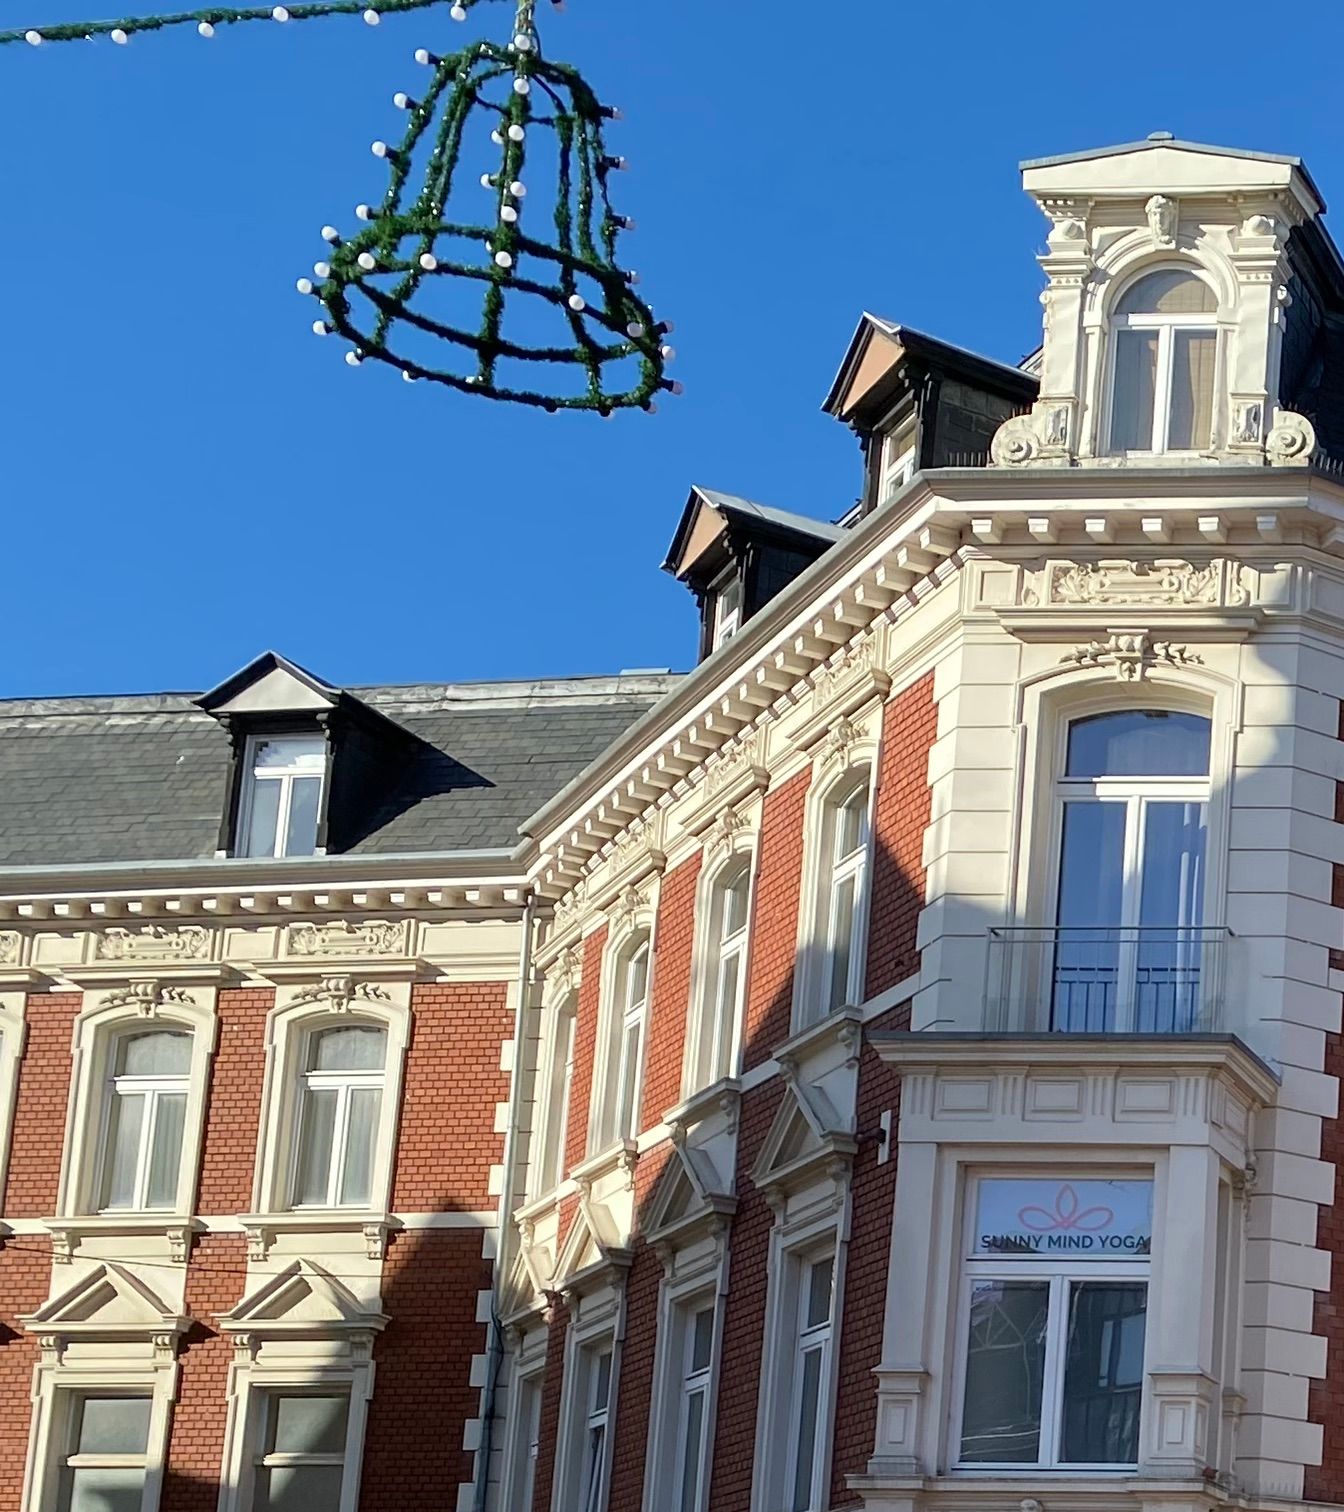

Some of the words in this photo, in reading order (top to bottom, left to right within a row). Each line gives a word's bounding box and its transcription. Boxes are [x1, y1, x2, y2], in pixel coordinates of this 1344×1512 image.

[981, 1235, 1043, 1249] SUNNY
[1047, 1235, 1093, 1249] MIND
[1098, 1235, 1150, 1249] YOGA
